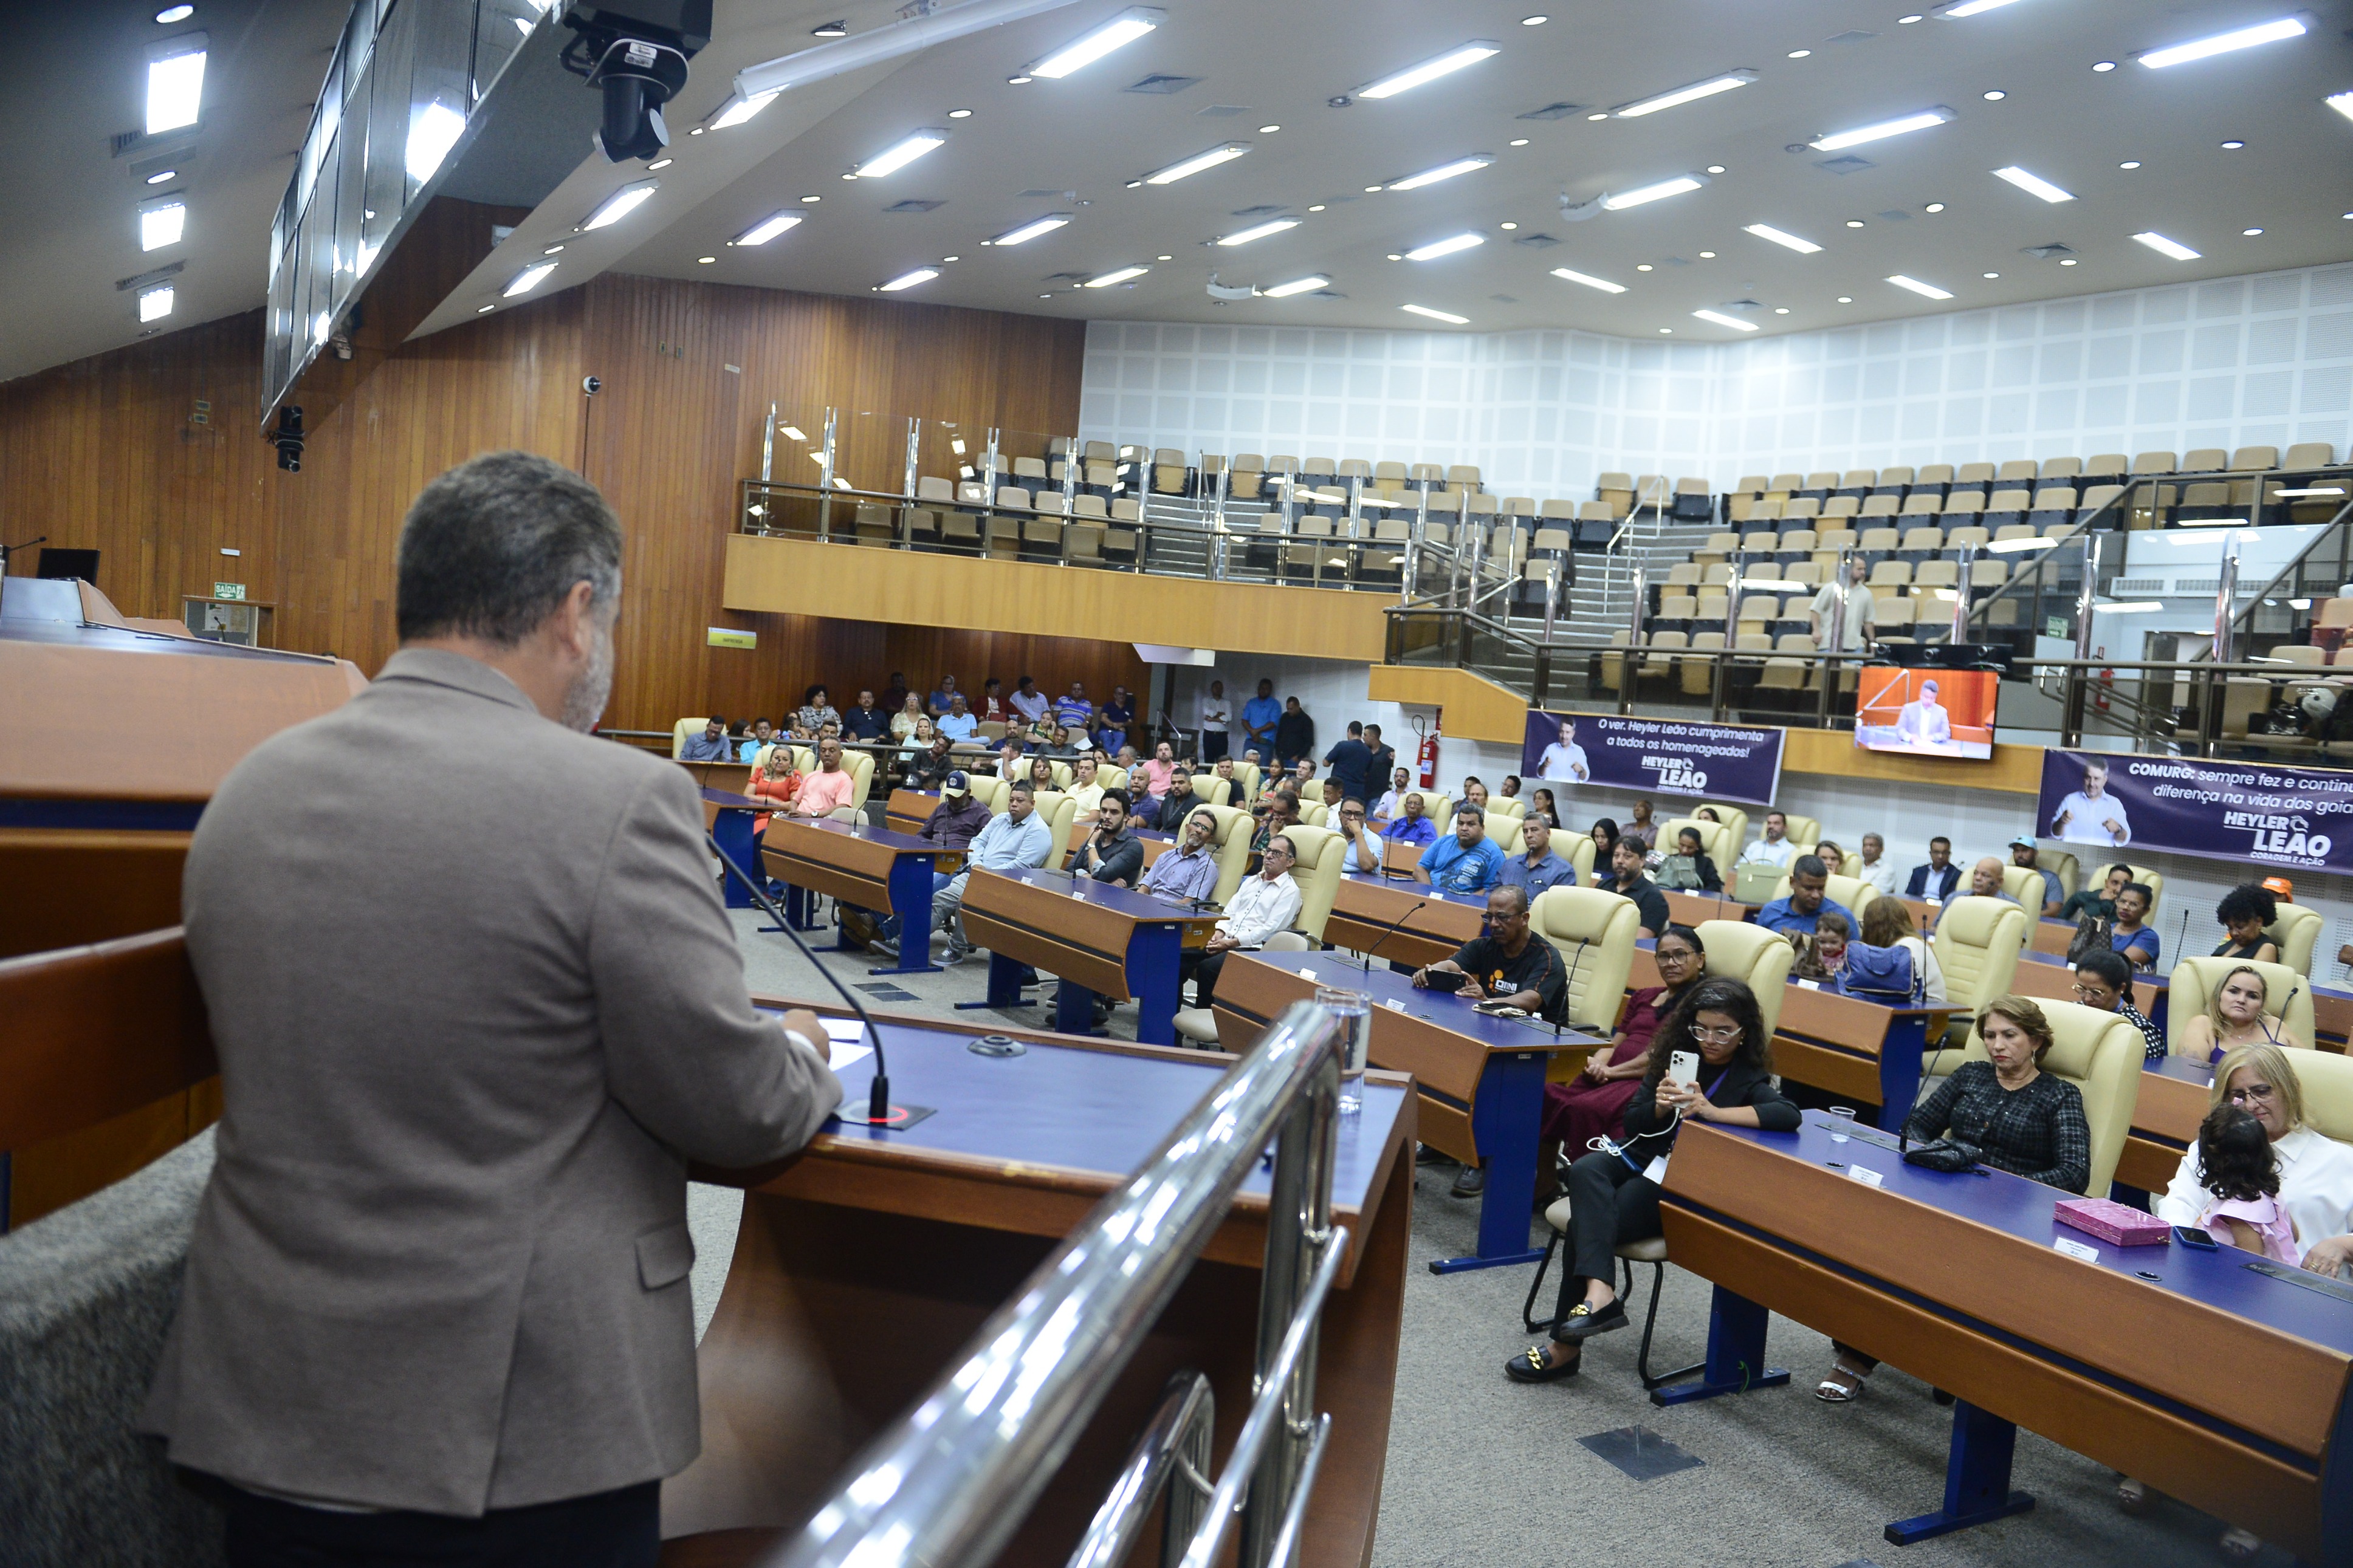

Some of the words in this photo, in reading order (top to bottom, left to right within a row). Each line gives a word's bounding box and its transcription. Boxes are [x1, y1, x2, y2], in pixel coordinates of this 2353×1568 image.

[1598, 719, 1607, 728] O
[1609, 721, 1626, 730] ver.
[1628, 721, 1661, 734] Heyler
[1661, 724, 1687, 735] Leão
[1688, 727, 1764, 741] cumprimenta
[1607, 737, 1615, 745] a
[1616, 736, 1645, 748] todos
[1646, 741, 1660, 750] os
[1661, 740, 1750, 758] homenageados!
[1641, 755, 1683, 769] HEYLER
[2129, 762, 2195, 779] COMURG:
[2197, 770, 2255, 786] sempre
[2258, 773, 2281, 787] fez
[2284, 778, 2295, 788] e
[2153, 784, 2220, 804] diferença
[2222, 792, 2244, 804] na
[2248, 793, 2281, 807] vida
[2283, 796, 2313, 810] dos
[2224, 811, 2289, 830] HEYLER
[2250, 851, 2292, 863] CORAGEM
[2299, 857, 2325, 866] AÇÃO
